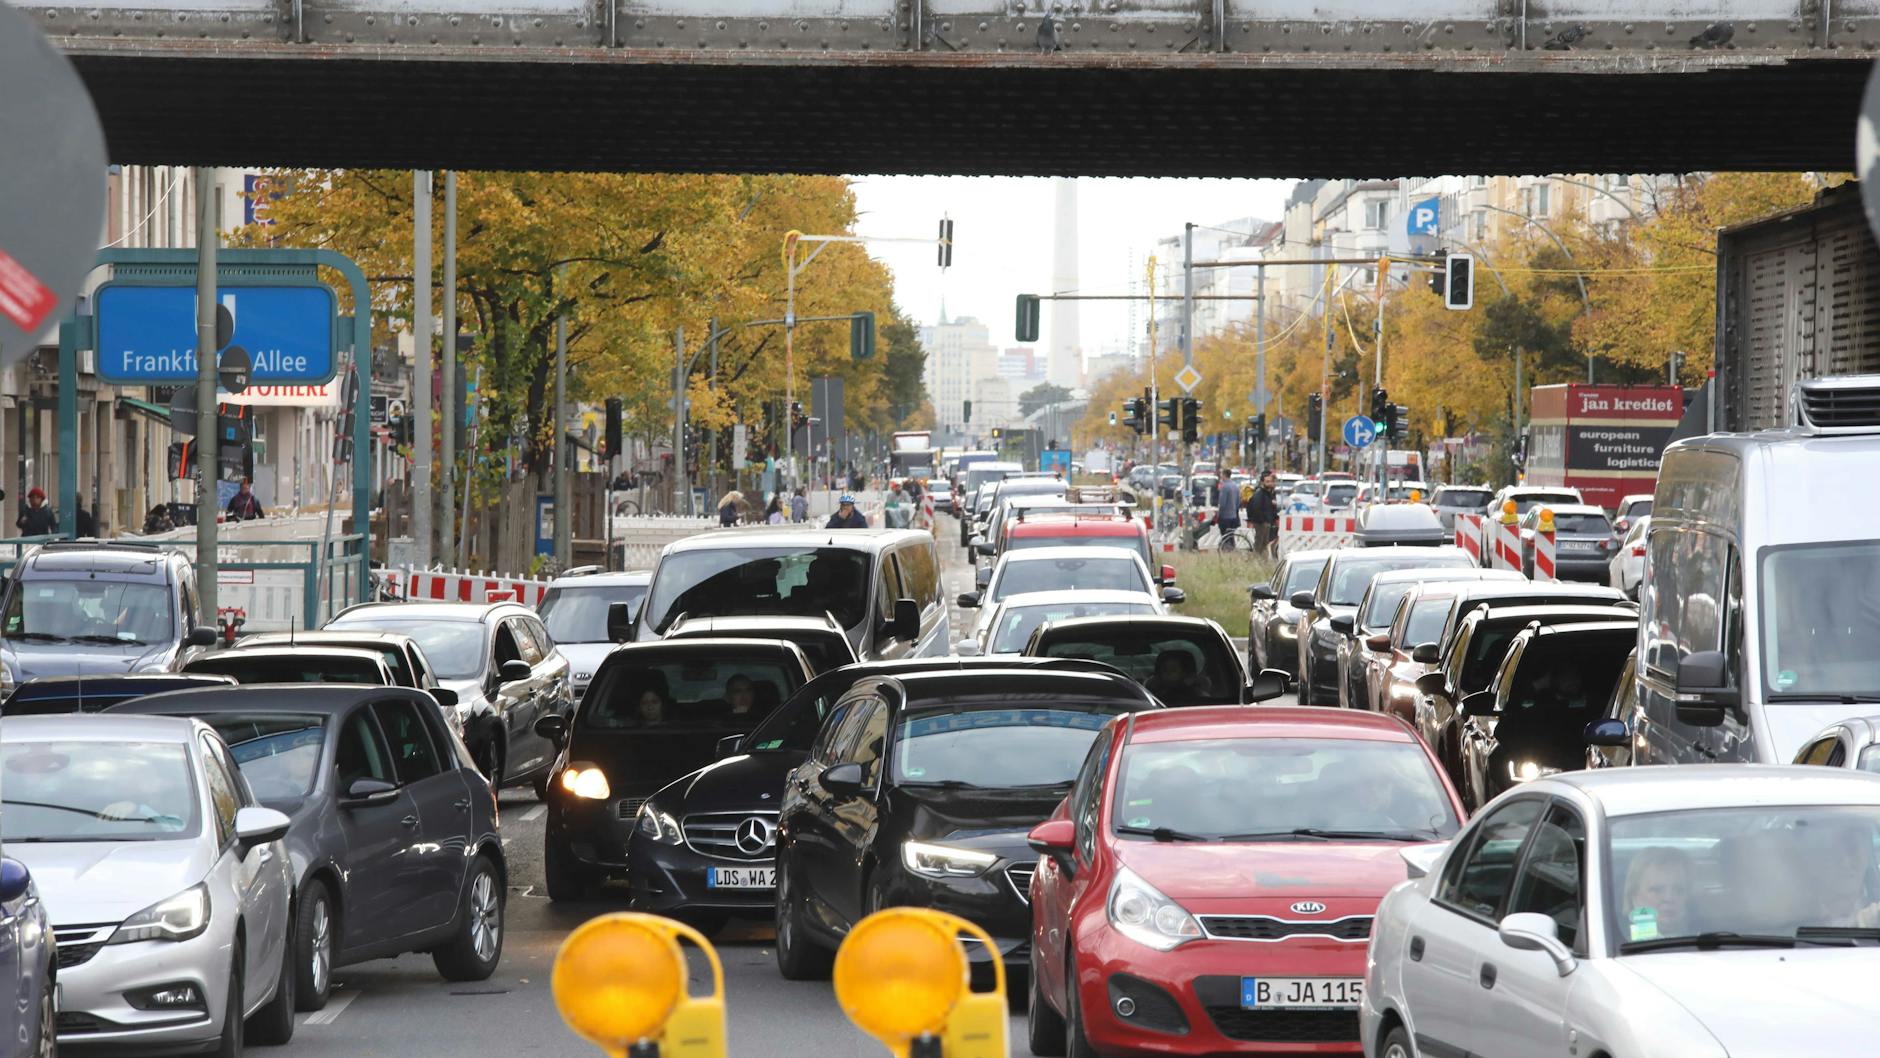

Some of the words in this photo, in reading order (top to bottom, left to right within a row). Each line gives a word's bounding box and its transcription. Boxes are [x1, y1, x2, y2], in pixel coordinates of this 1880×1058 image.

[253, 350, 307, 372] Allee
[1581, 397, 1609, 413] jan
[1614, 398, 1673, 412] krediet
[1579, 431, 1640, 440] european
[1593, 443, 1654, 453] furniture
[716, 870, 739, 886] LDS
[749, 870, 766, 886] WA
[1297, 903, 1321, 911] KIA
[1257, 982, 1271, 1003] B
[1287, 982, 1316, 1003] JA
[1322, 982, 1363, 1003] 115
